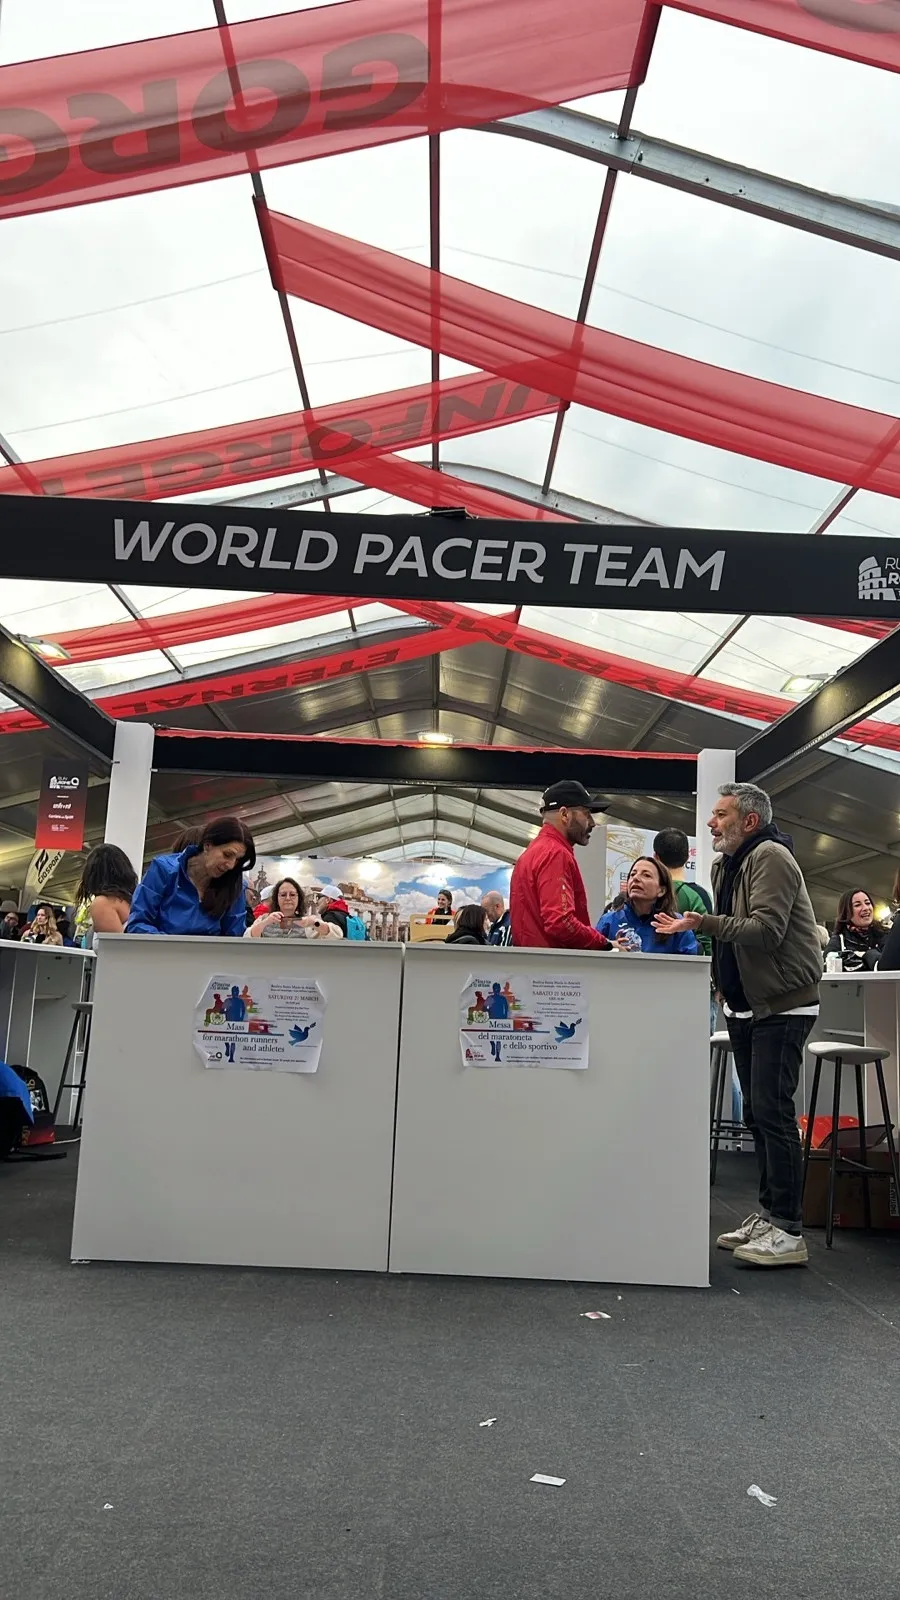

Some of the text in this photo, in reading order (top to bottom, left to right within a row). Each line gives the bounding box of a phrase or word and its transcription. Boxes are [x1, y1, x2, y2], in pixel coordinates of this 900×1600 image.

[114, 518, 726, 591] WORLD PACER TEAM
[419, 601, 609, 680] ROME
[112, 648, 400, 713] ETERNAL
[227, 1023, 245, 1031] Mass
[489, 1020, 511, 1029] Messa
[478, 1032, 532, 1041] del maratoneta
[242, 1044, 285, 1053] and athletes
[509, 1041, 527, 1050] dello
[528, 1042, 558, 1052] sportivo
